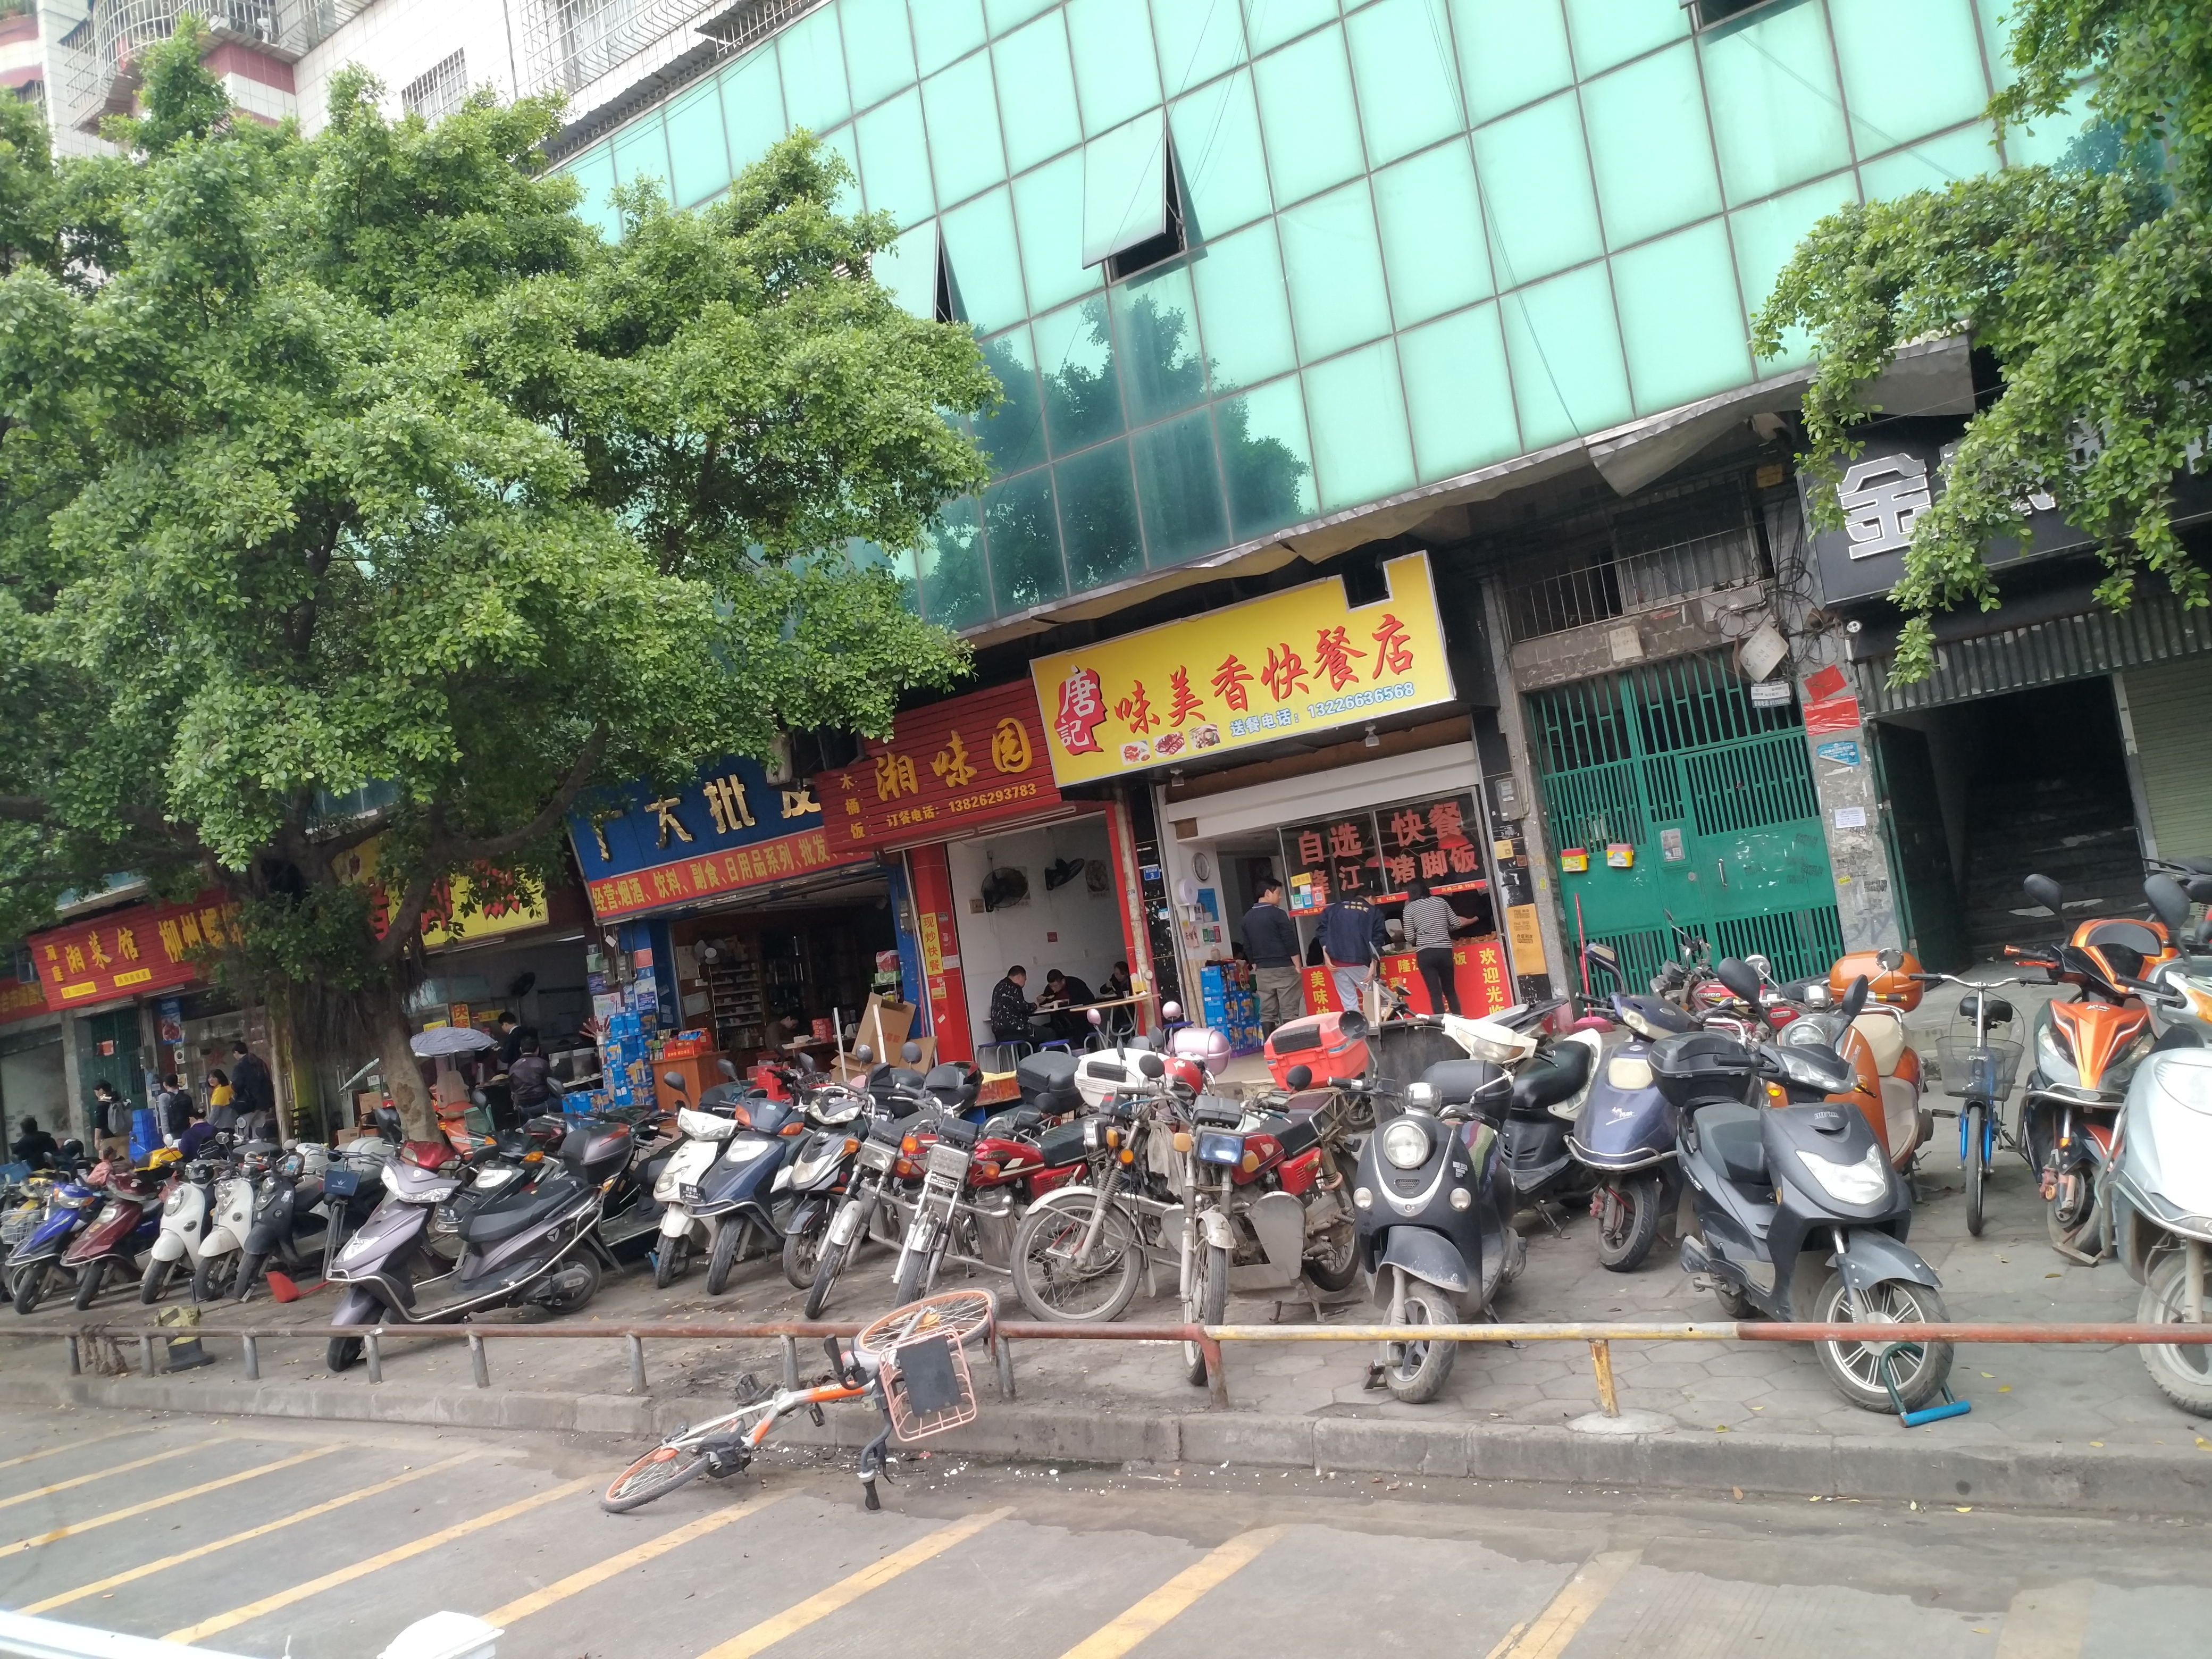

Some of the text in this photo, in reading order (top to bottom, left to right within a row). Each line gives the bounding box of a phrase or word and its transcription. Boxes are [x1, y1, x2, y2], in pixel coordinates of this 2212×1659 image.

[1113, 614, 1414, 734] 味美香快餐店
[875, 717, 1032, 801] 湘味园
[840, 774, 865, 839] 木桶饭
[1298, 801, 1462, 865] 自选 快餐
[1390, 844, 1479, 884] 猪脚饭
[65, 927, 139, 974] 湘菜馆
[923, 916, 940, 971] 现炒快餐
